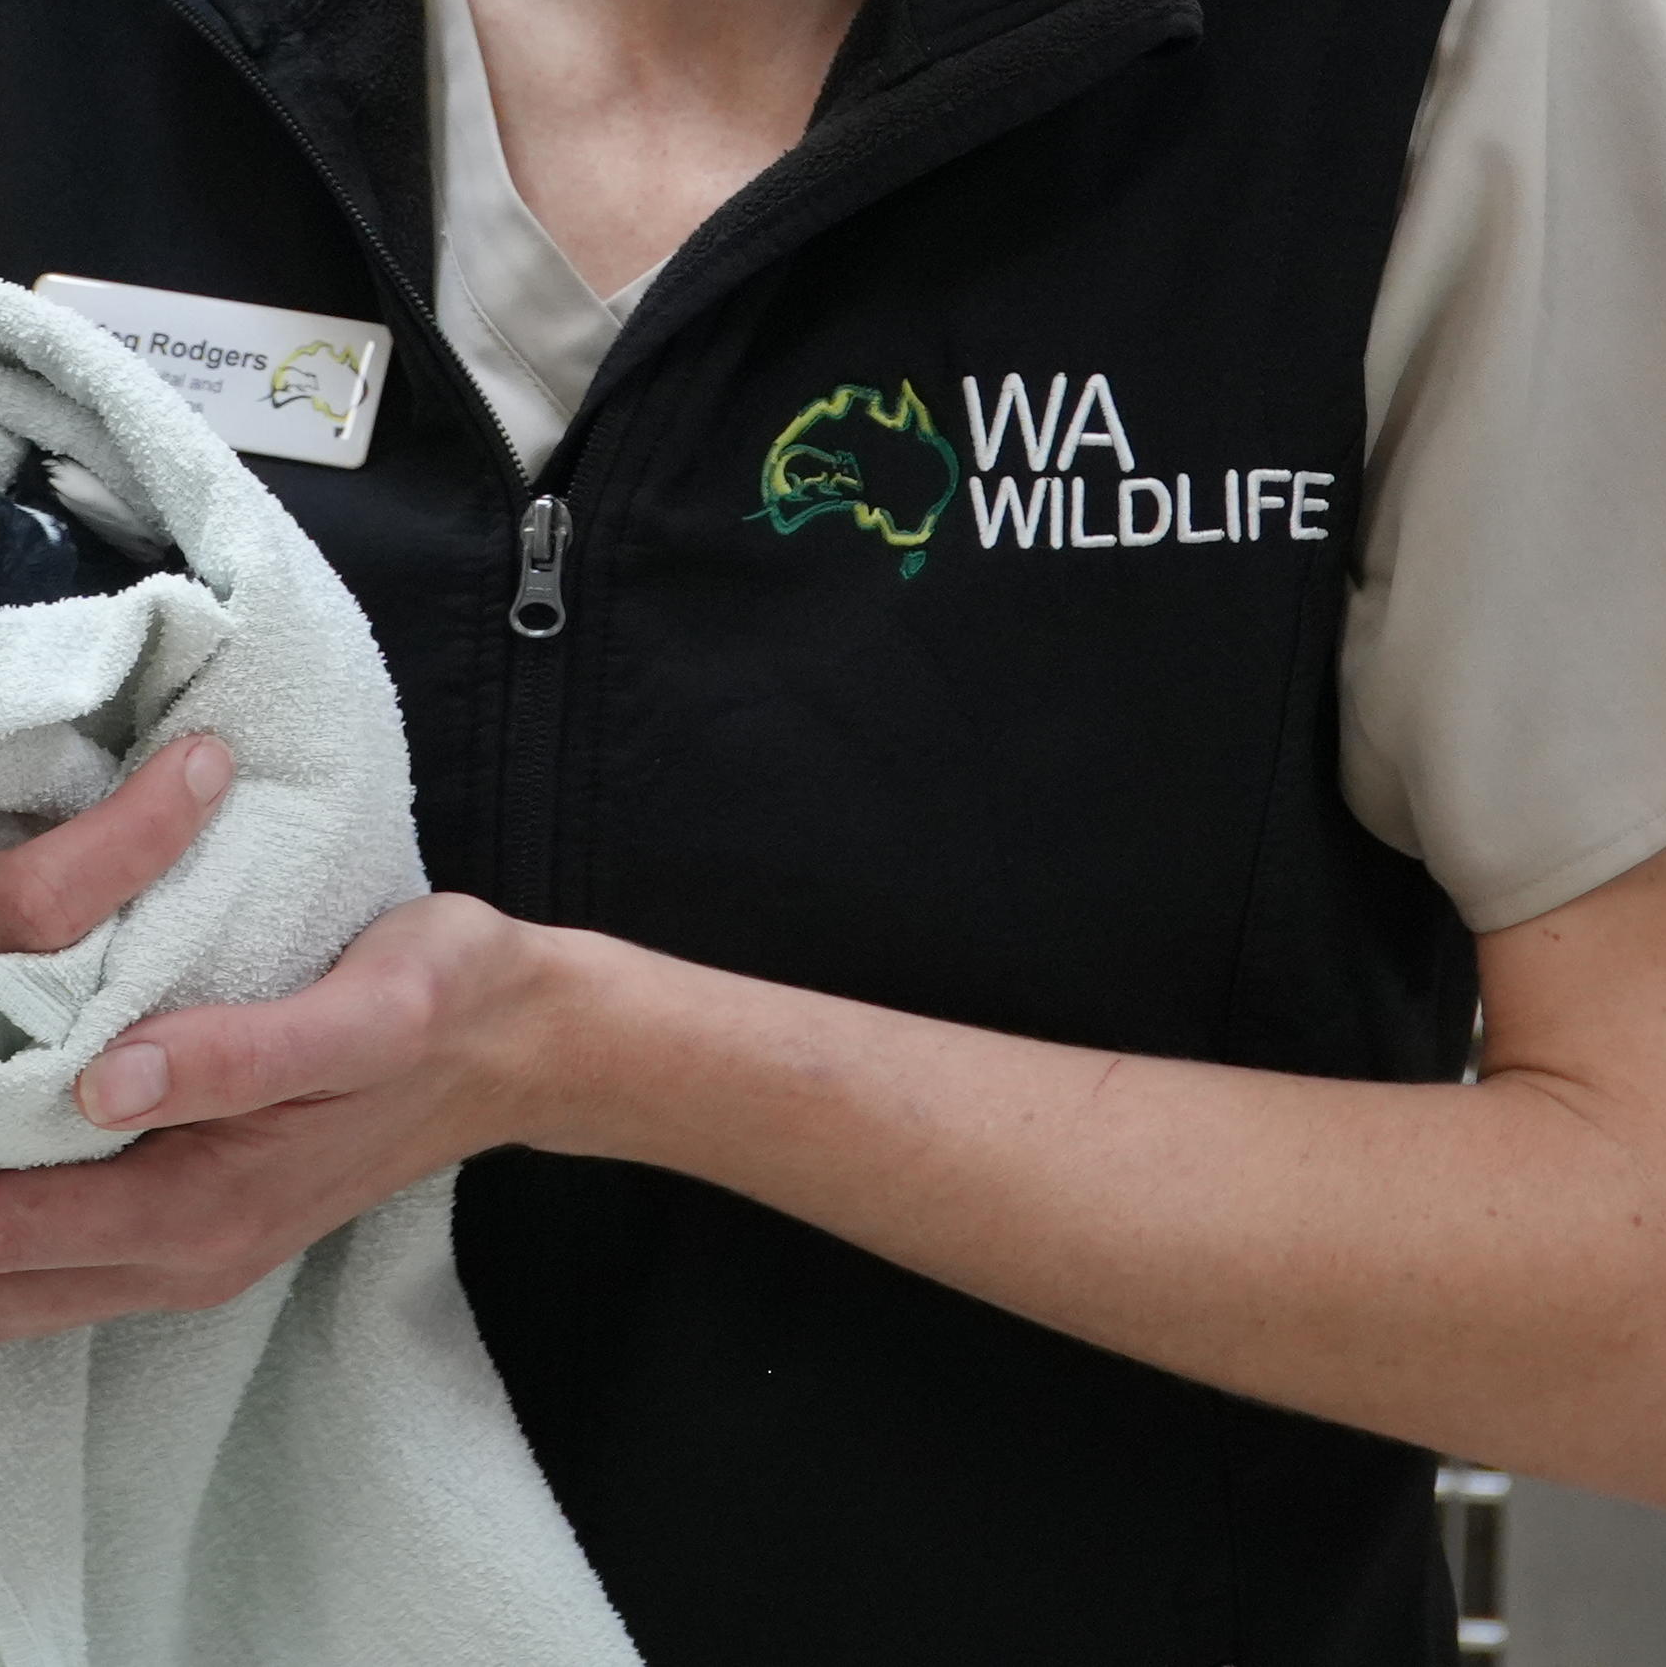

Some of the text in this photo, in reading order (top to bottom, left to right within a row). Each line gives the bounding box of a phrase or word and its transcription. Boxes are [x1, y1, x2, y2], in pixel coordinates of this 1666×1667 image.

[149, 332, 269, 371] Rodgers
[189, 376, 225, 394] and
[962, 372, 1136, 473] WA
[967, 468, 1335, 550] WILDLIFE
